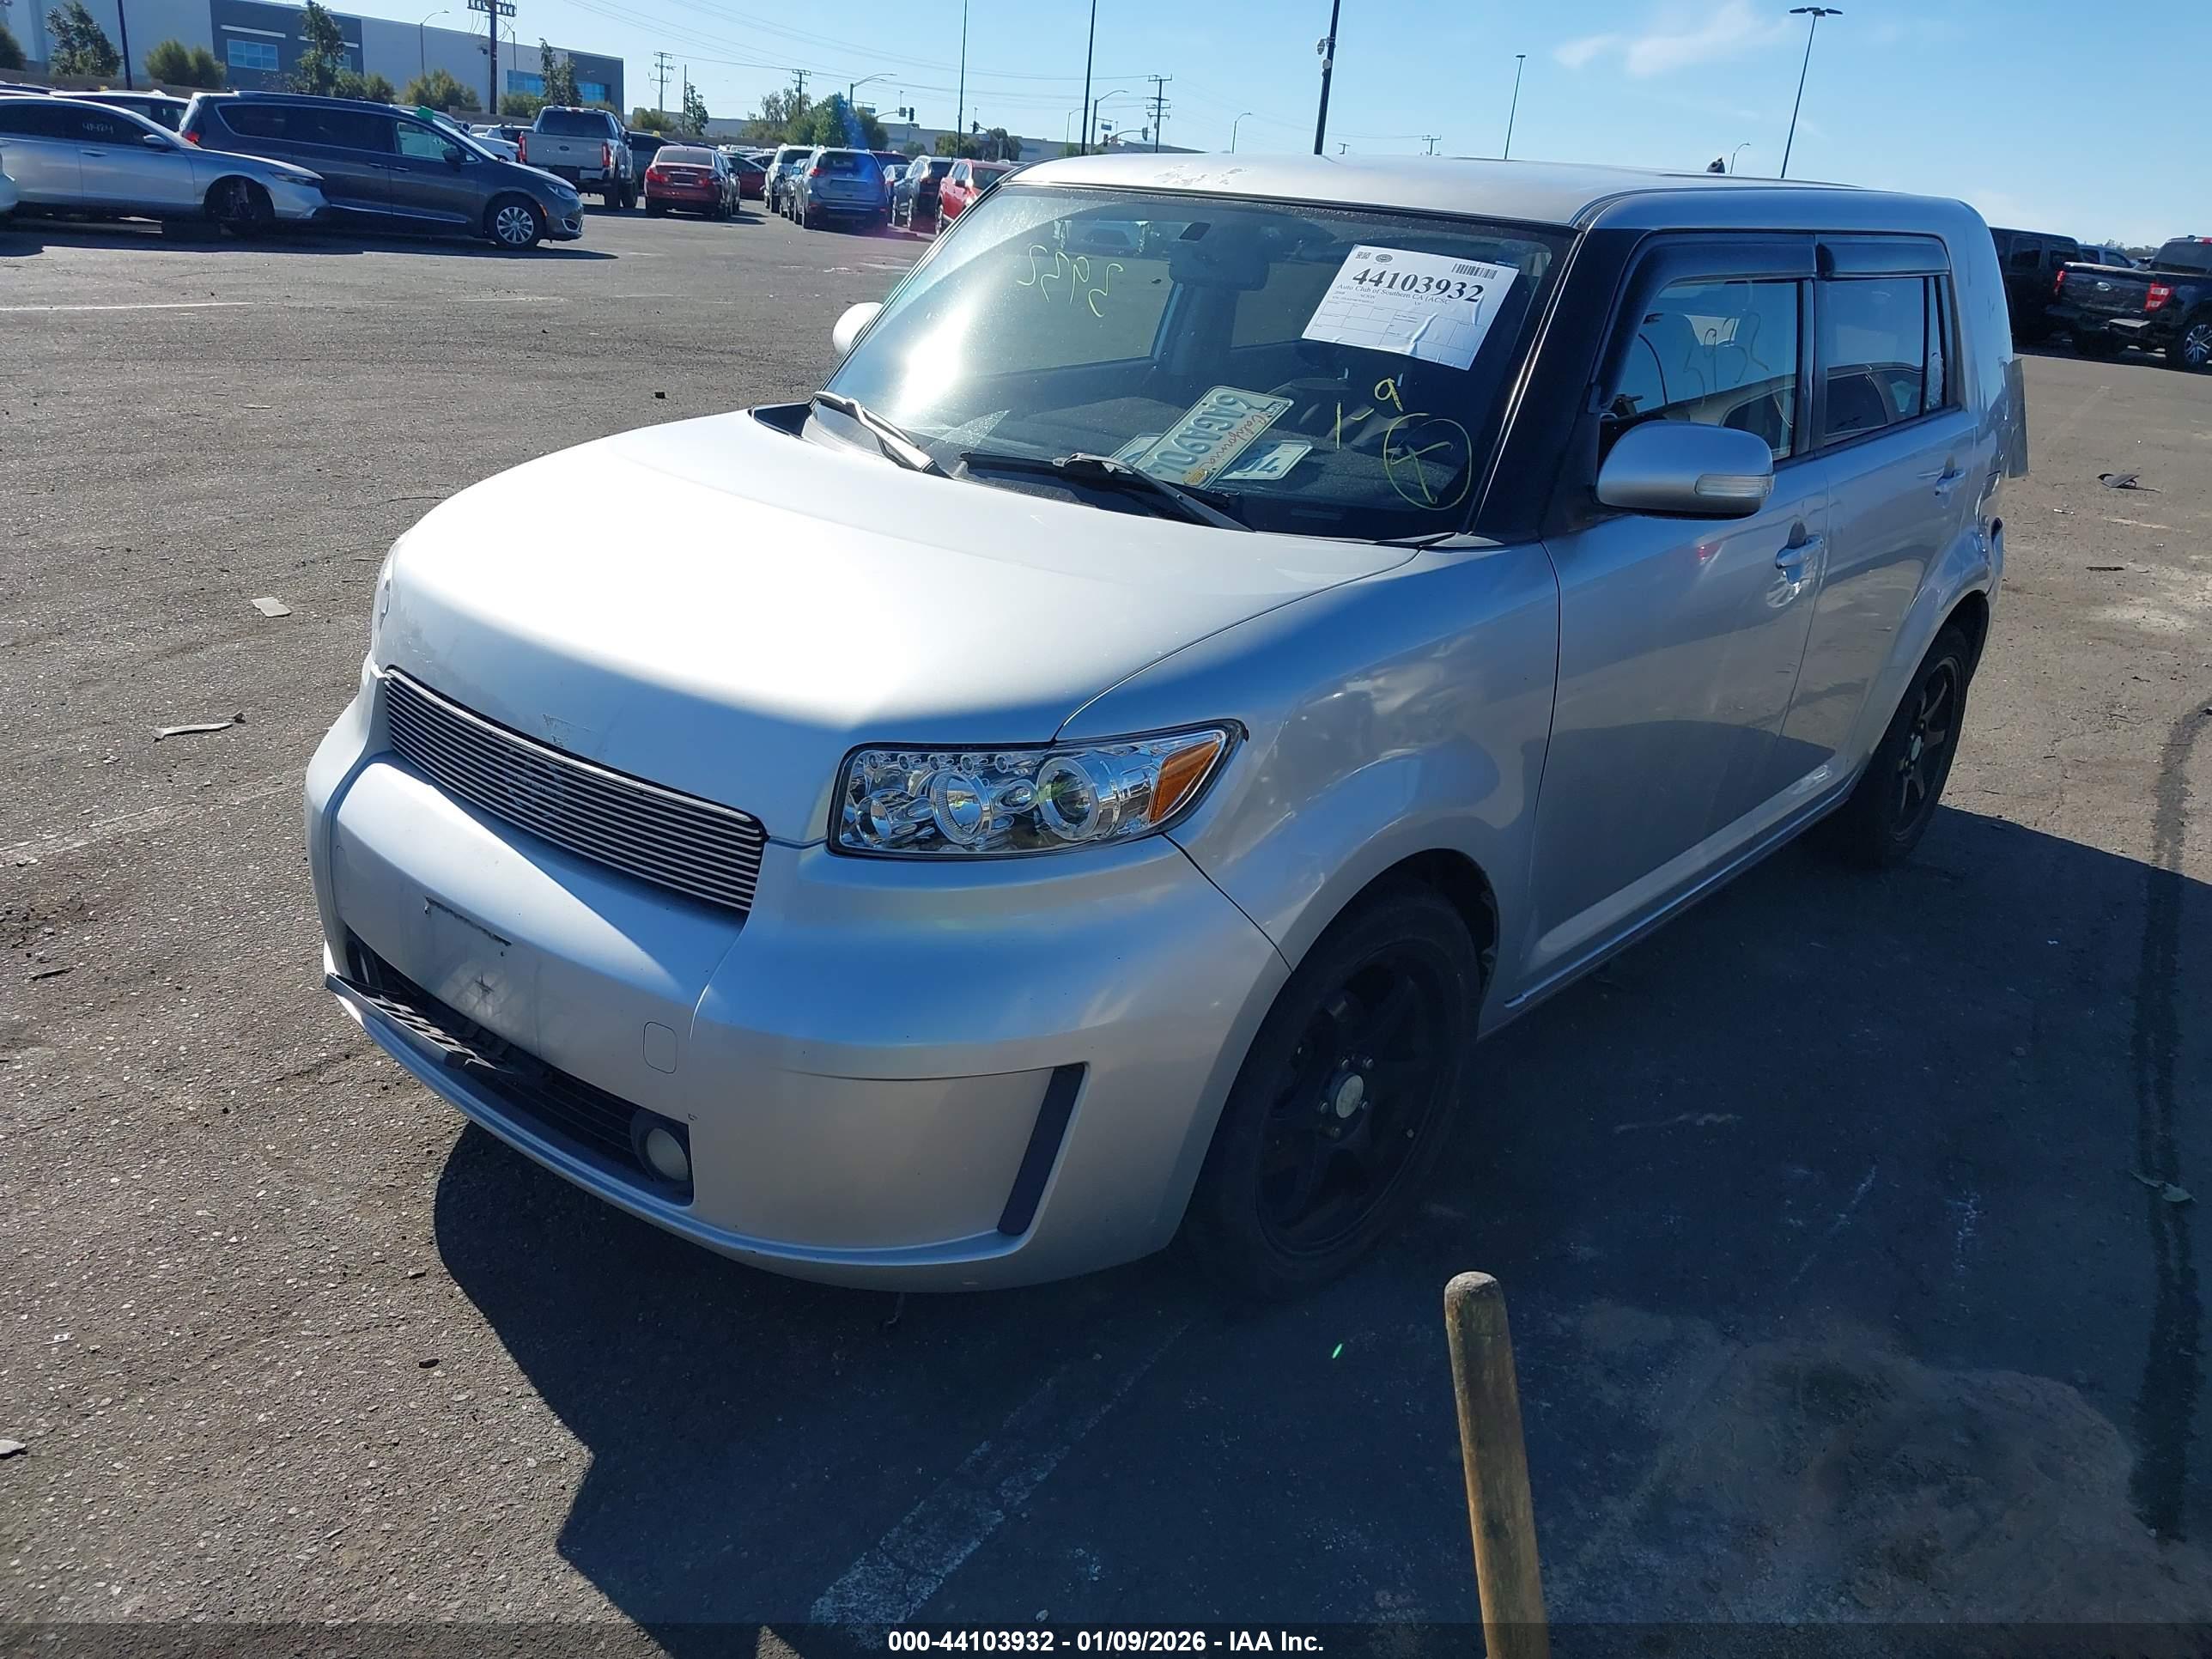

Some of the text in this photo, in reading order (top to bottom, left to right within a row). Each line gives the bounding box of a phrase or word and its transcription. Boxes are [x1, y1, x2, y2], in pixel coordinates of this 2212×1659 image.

[1352, 267, 1485, 303] 44103932
[1355, 284, 1371, 293] Club
[1381, 289, 1411, 299] Southern
[1198, 414, 1266, 468] California
